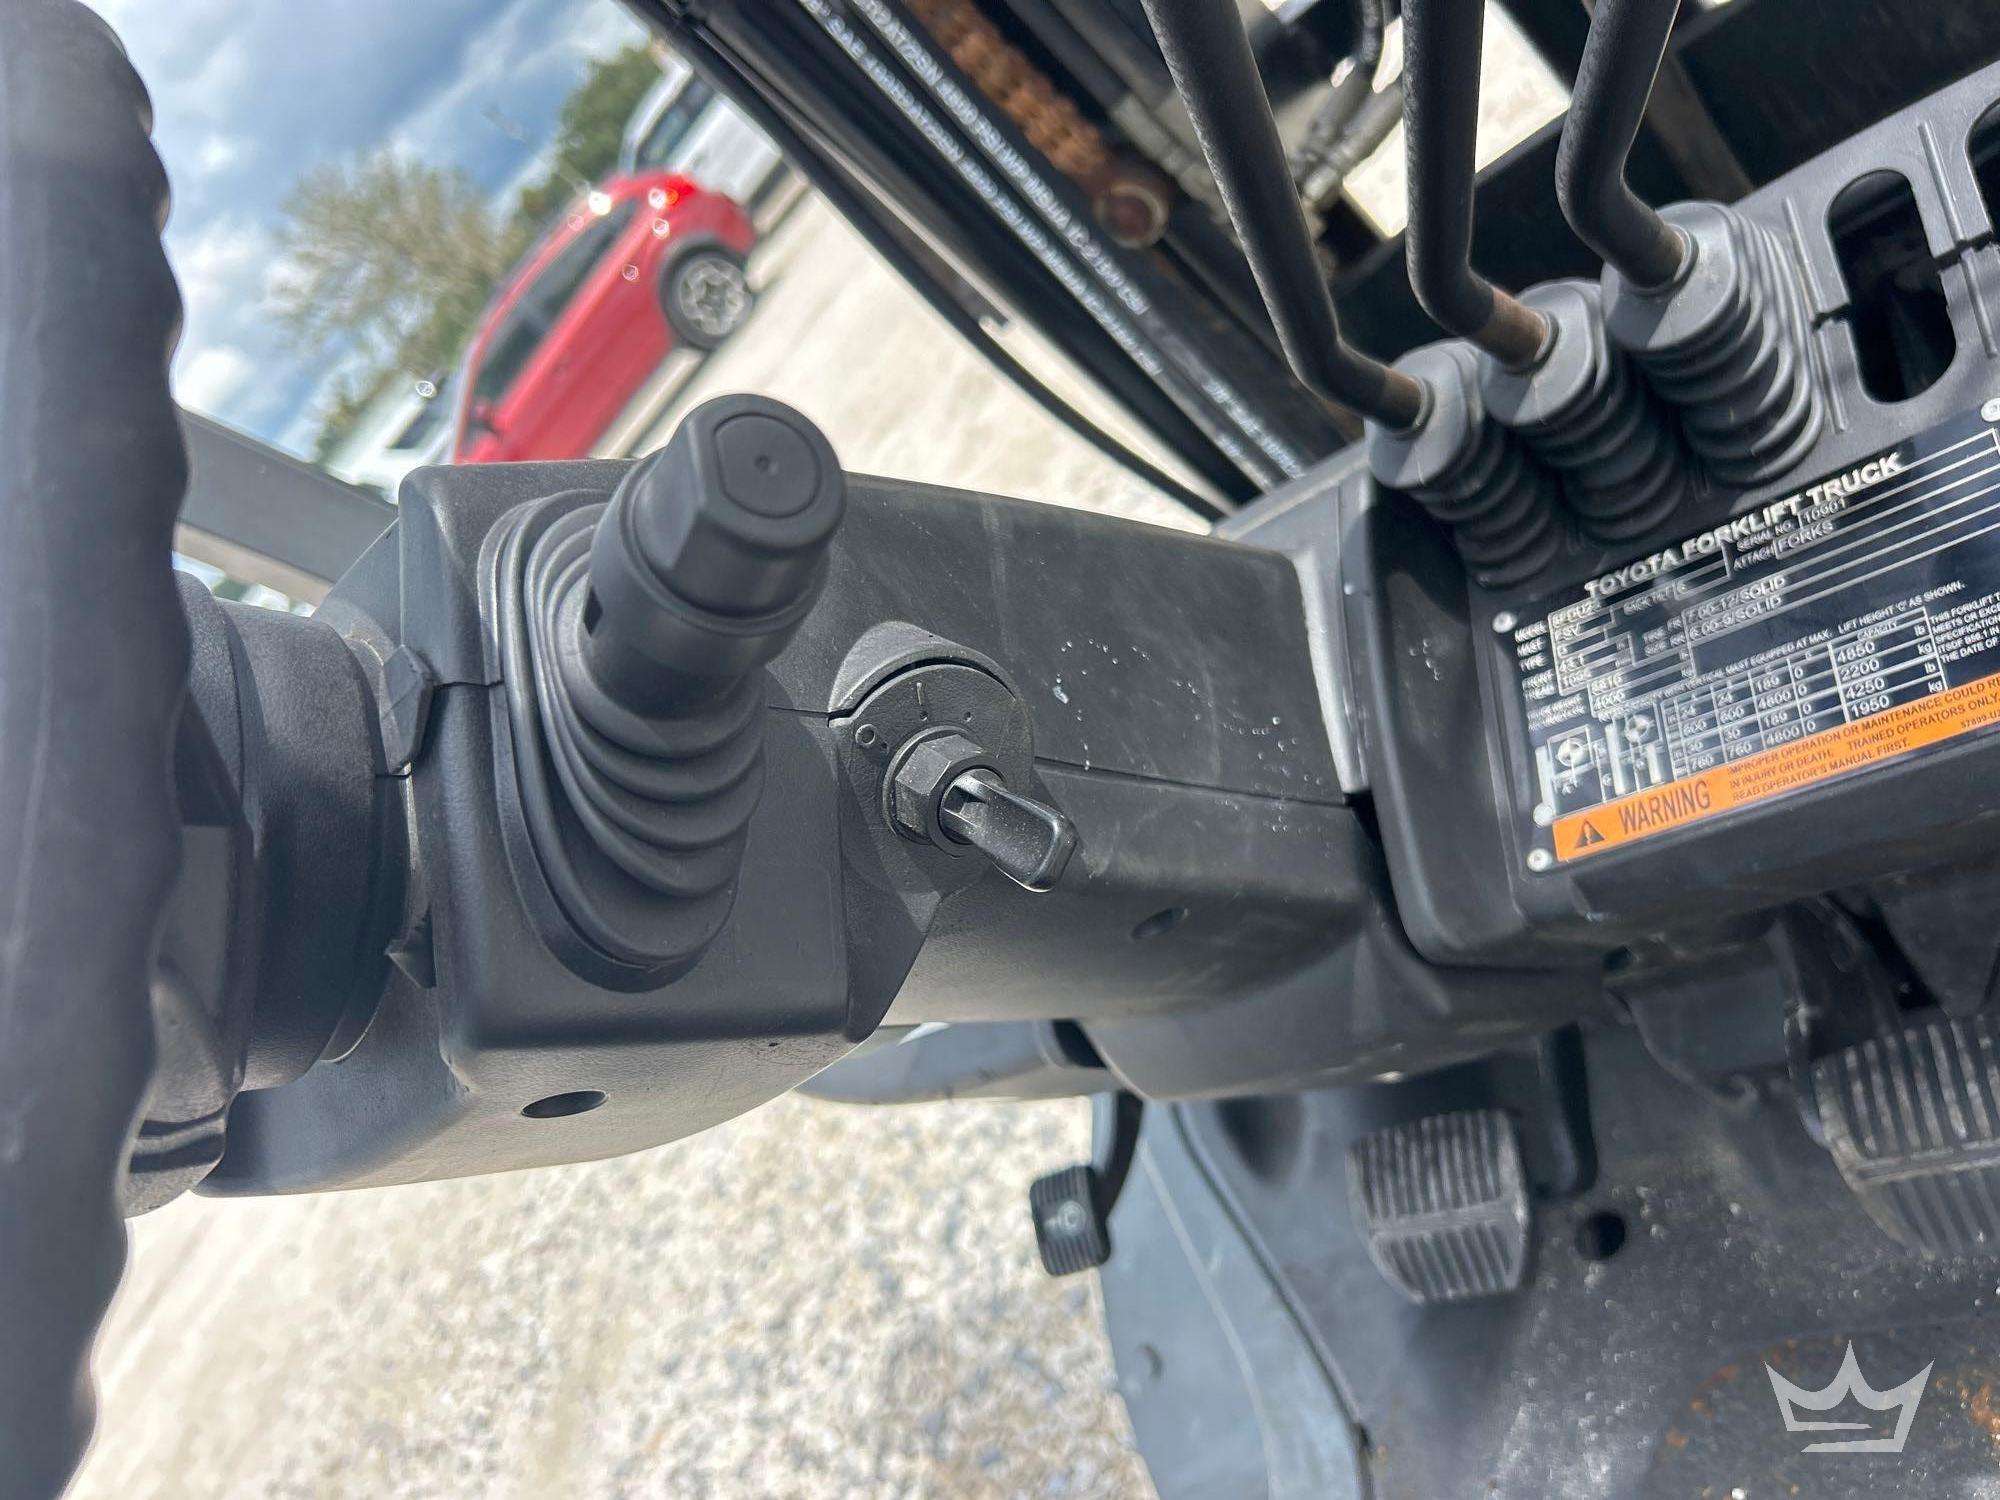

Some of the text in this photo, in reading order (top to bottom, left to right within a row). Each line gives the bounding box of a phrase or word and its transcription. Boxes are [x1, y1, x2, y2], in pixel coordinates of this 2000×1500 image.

[1583, 450, 1903, 602] TOYOTA FORKLIFT TRUCK
[1735, 526, 1773, 553] SERIAL
[1777, 517, 1833, 552] FORKS
[1838, 618, 1857, 635] LIFT
[1858, 605, 1894, 627] HEIGHT
[1908, 594, 1923, 609] AS
[1950, 594, 1994, 618] FORKLIFT
[1913, 622, 1926, 637] lb
[1932, 615, 1963, 635] MEETS
[1835, 638, 1876, 665] 4850
[1916, 639, 1932, 657] kg
[1940, 649, 1959, 665] THE
[1959, 640, 1984, 658] DATE
[1839, 655, 1881, 683] 2200
[1924, 659, 1936, 674] lb
[1844, 674, 1885, 701] 4250
[1927, 676, 1943, 694] kg
[1850, 692, 1890, 719] 1950
[1726, 751, 1778, 777] IMPROPER
[1779, 729, 1841, 760] OPERATION
[1842, 723, 1860, 738] OR
[1860, 695, 1942, 732] MAINTENANCE
[1943, 680, 1986, 704] COULD
[1740, 765, 1778, 787] INJURY
[1777, 759, 1794, 774] OR
[1846, 726, 1895, 751] TRAINED
[1895, 702, 1966, 736] OPERATORS
[1732, 785, 1760, 803] READ
[1828, 747, 1875, 772] MANUAL
[1617, 777, 1712, 835] WARNING
